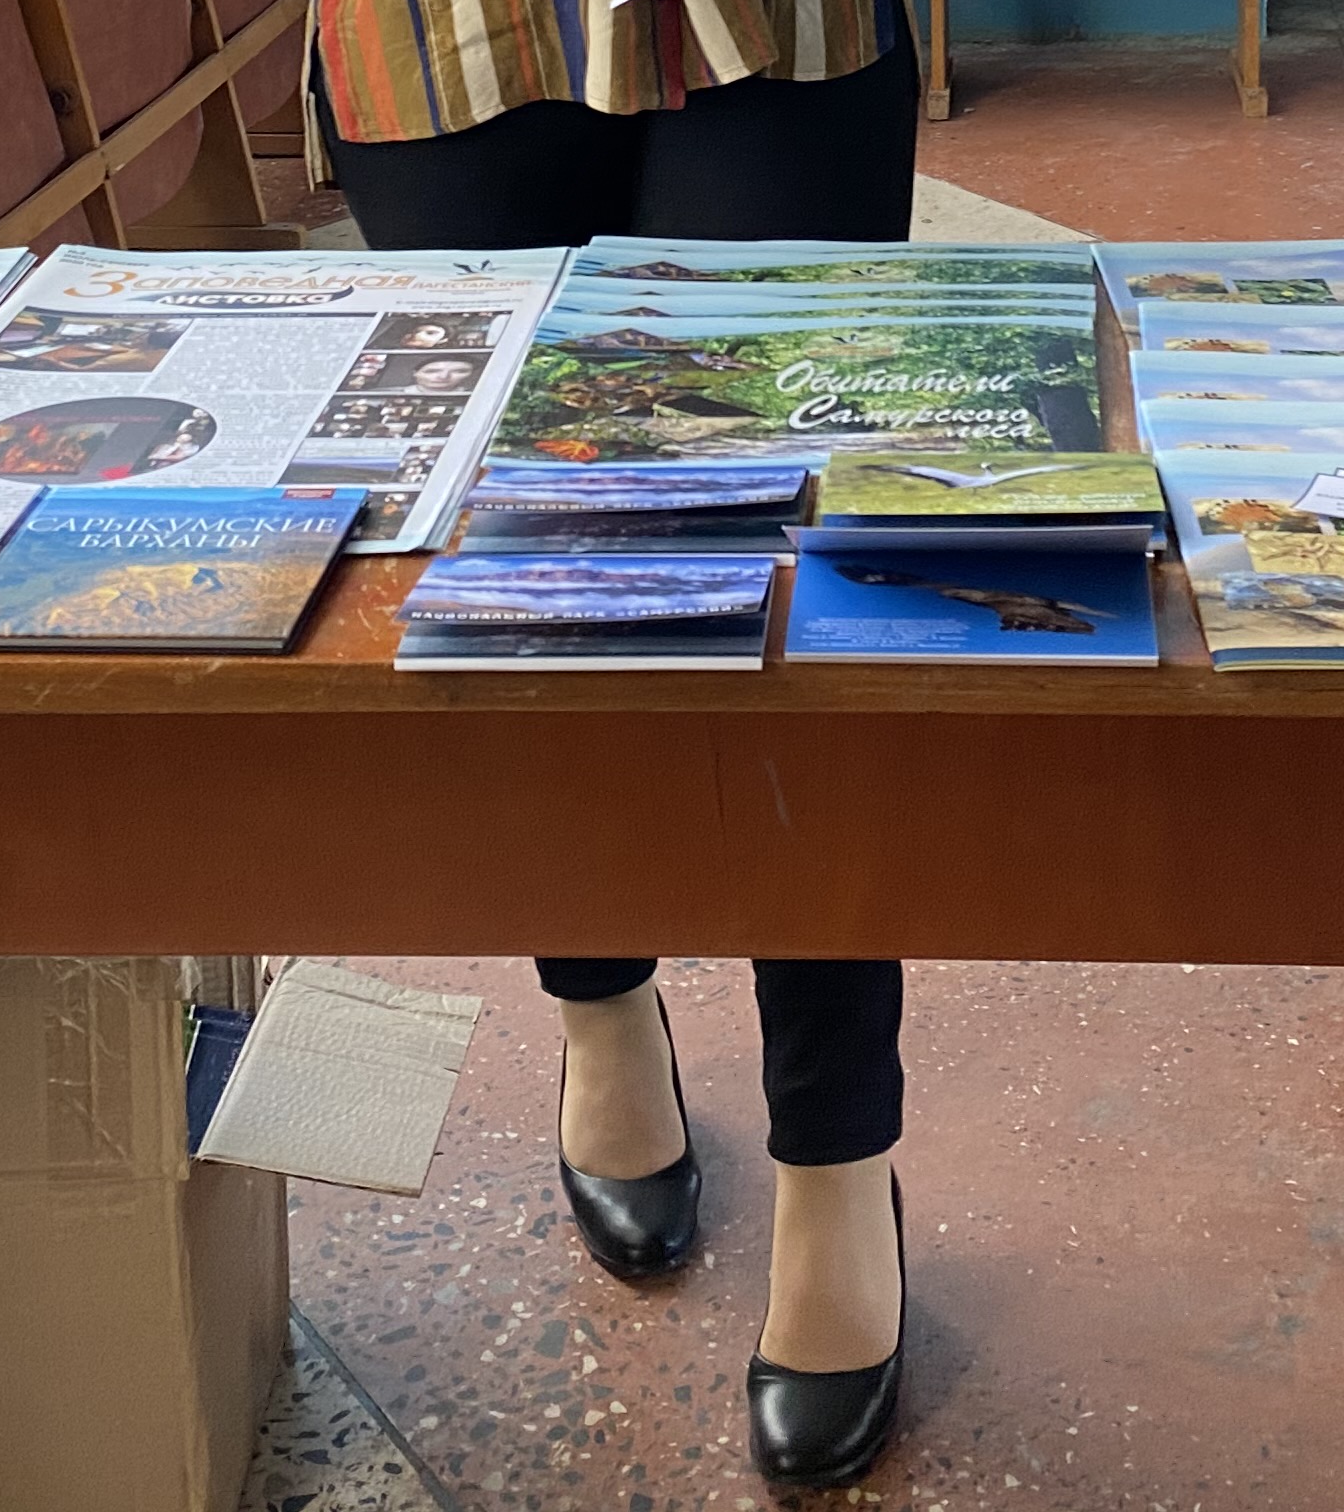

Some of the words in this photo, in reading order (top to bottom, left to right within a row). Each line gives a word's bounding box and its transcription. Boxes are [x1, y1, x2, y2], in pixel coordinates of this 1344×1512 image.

[776, 359, 1016, 393] Обитатели
[788, 393, 1030, 430] Самурского
[944, 423, 1033, 439] леса
[26, 517, 338, 536] САРЫКУМСКИЕ
[79, 534, 262, 548] БАРХАНЫ
[411, 611, 554, 620] НАЦИОНАЛЬНЫЙ
